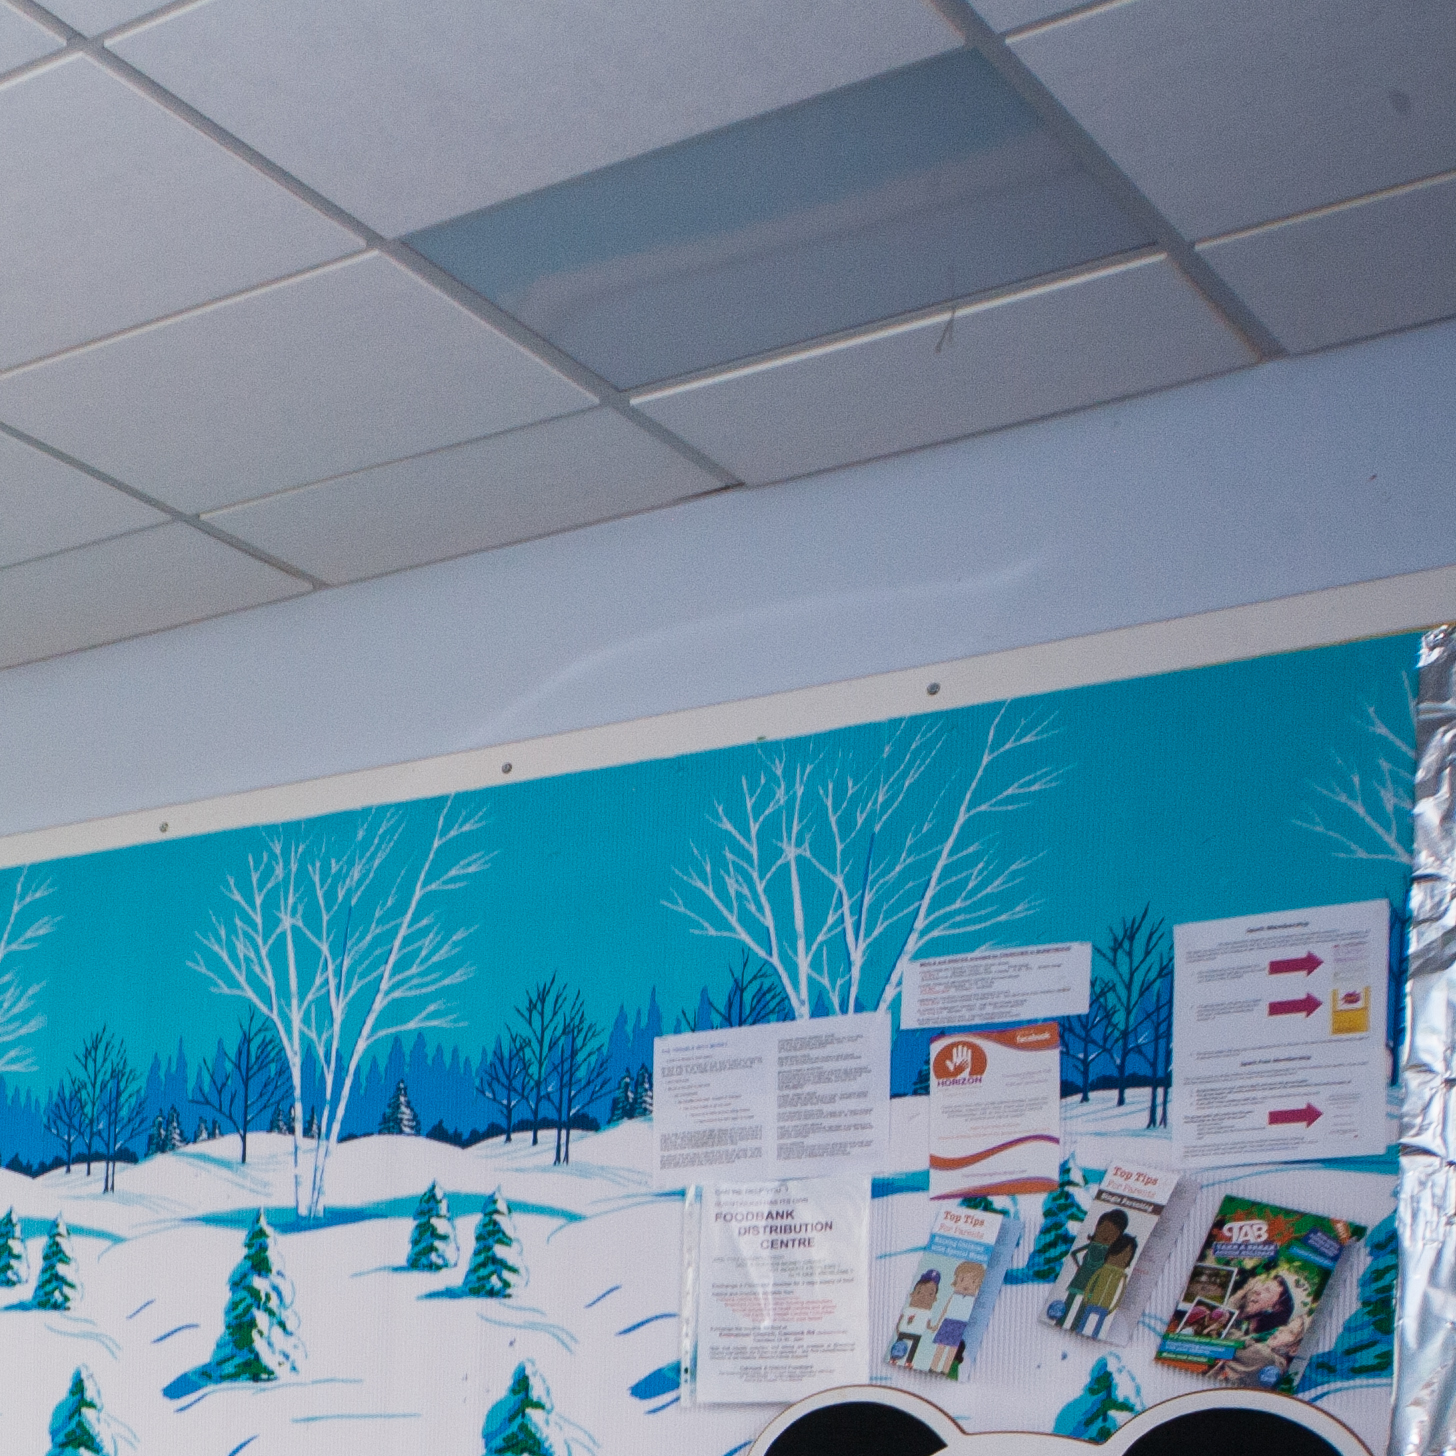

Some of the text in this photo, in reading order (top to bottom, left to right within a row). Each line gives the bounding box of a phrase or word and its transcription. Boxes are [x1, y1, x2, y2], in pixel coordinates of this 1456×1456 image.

[936, 1076, 982, 1087] HORIZON
[1111, 1165, 1159, 1189] Top Tips
[1122, 1183, 1156, 1200] Parents
[715, 1209, 795, 1222] FOODBANK
[942, 1209, 985, 1229] Top Tips
[738, 1221, 833, 1236] DISTRIBUTION
[1222, 1220, 1269, 1243] TAB
[760, 1237, 815, 1250] CENTRE
